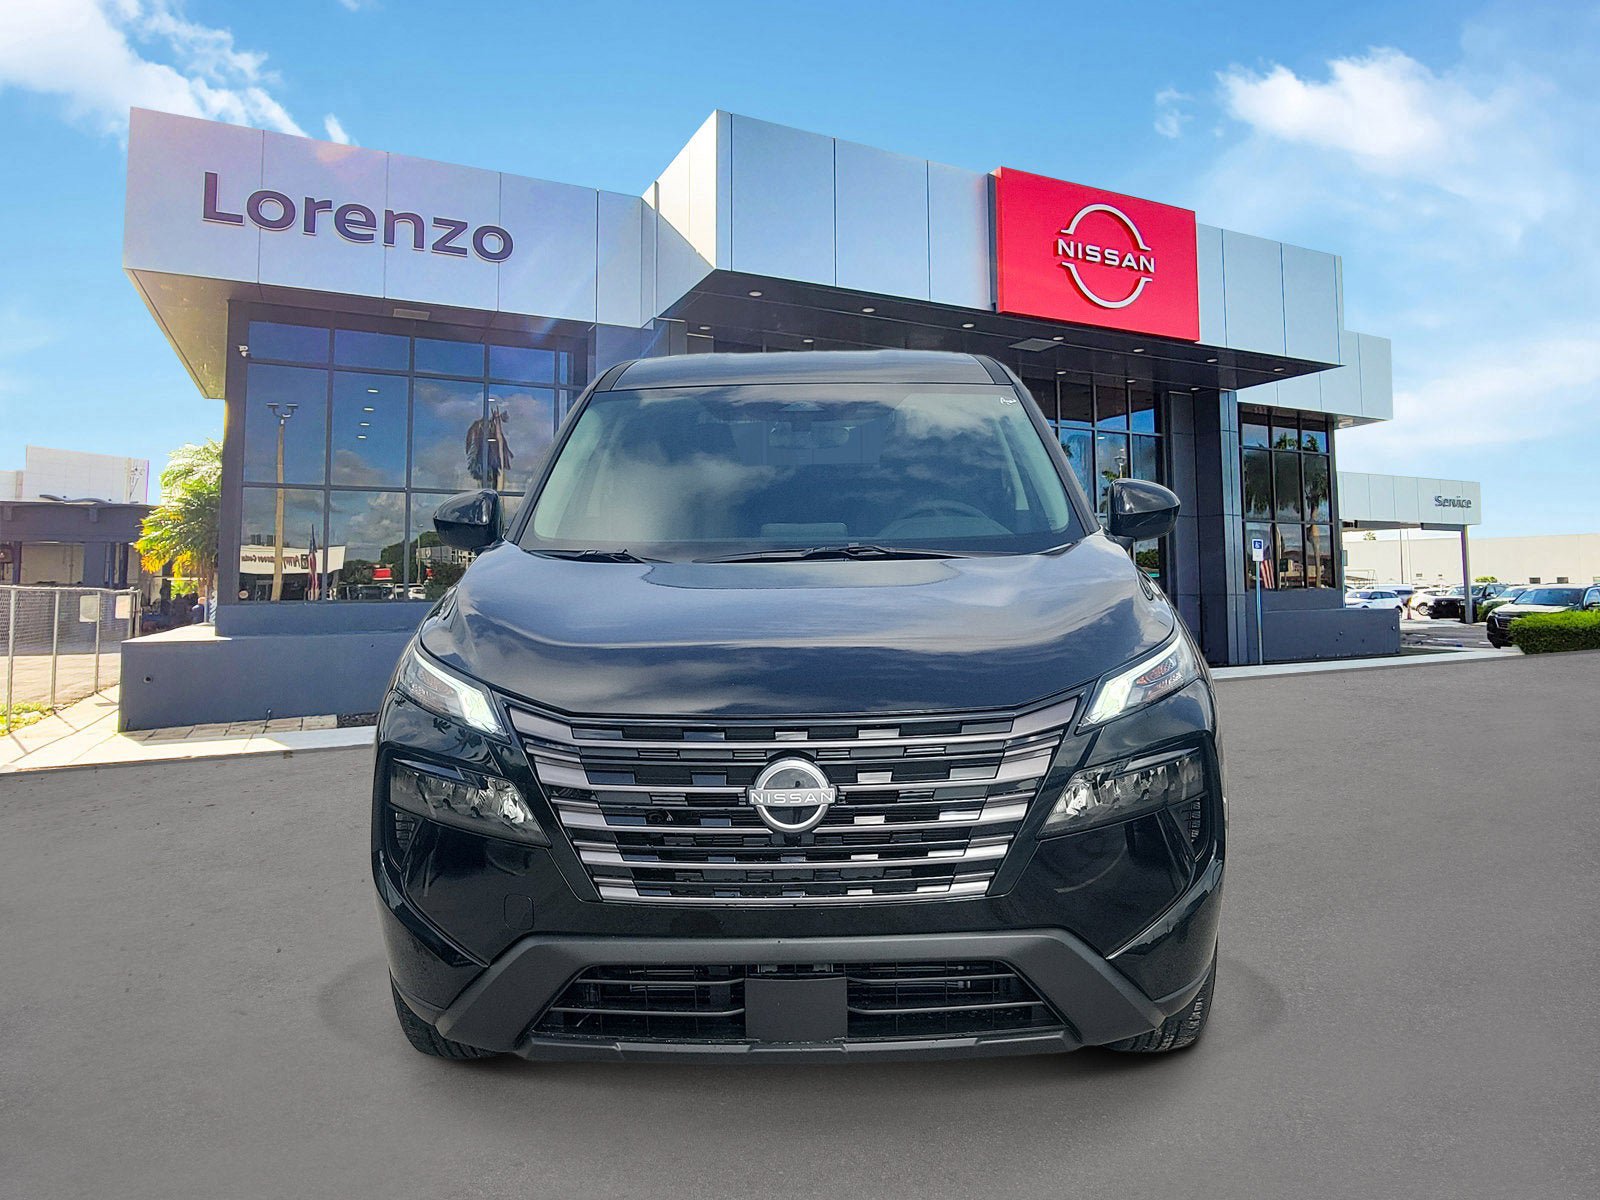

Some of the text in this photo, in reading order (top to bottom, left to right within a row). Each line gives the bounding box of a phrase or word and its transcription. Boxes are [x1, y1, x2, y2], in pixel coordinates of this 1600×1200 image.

[202, 171, 513, 262] Lorenzo
[1057, 238, 1155, 273] NISSAN
[1434, 495, 1472, 508] Service
[751, 792, 833, 804] NISSAN
